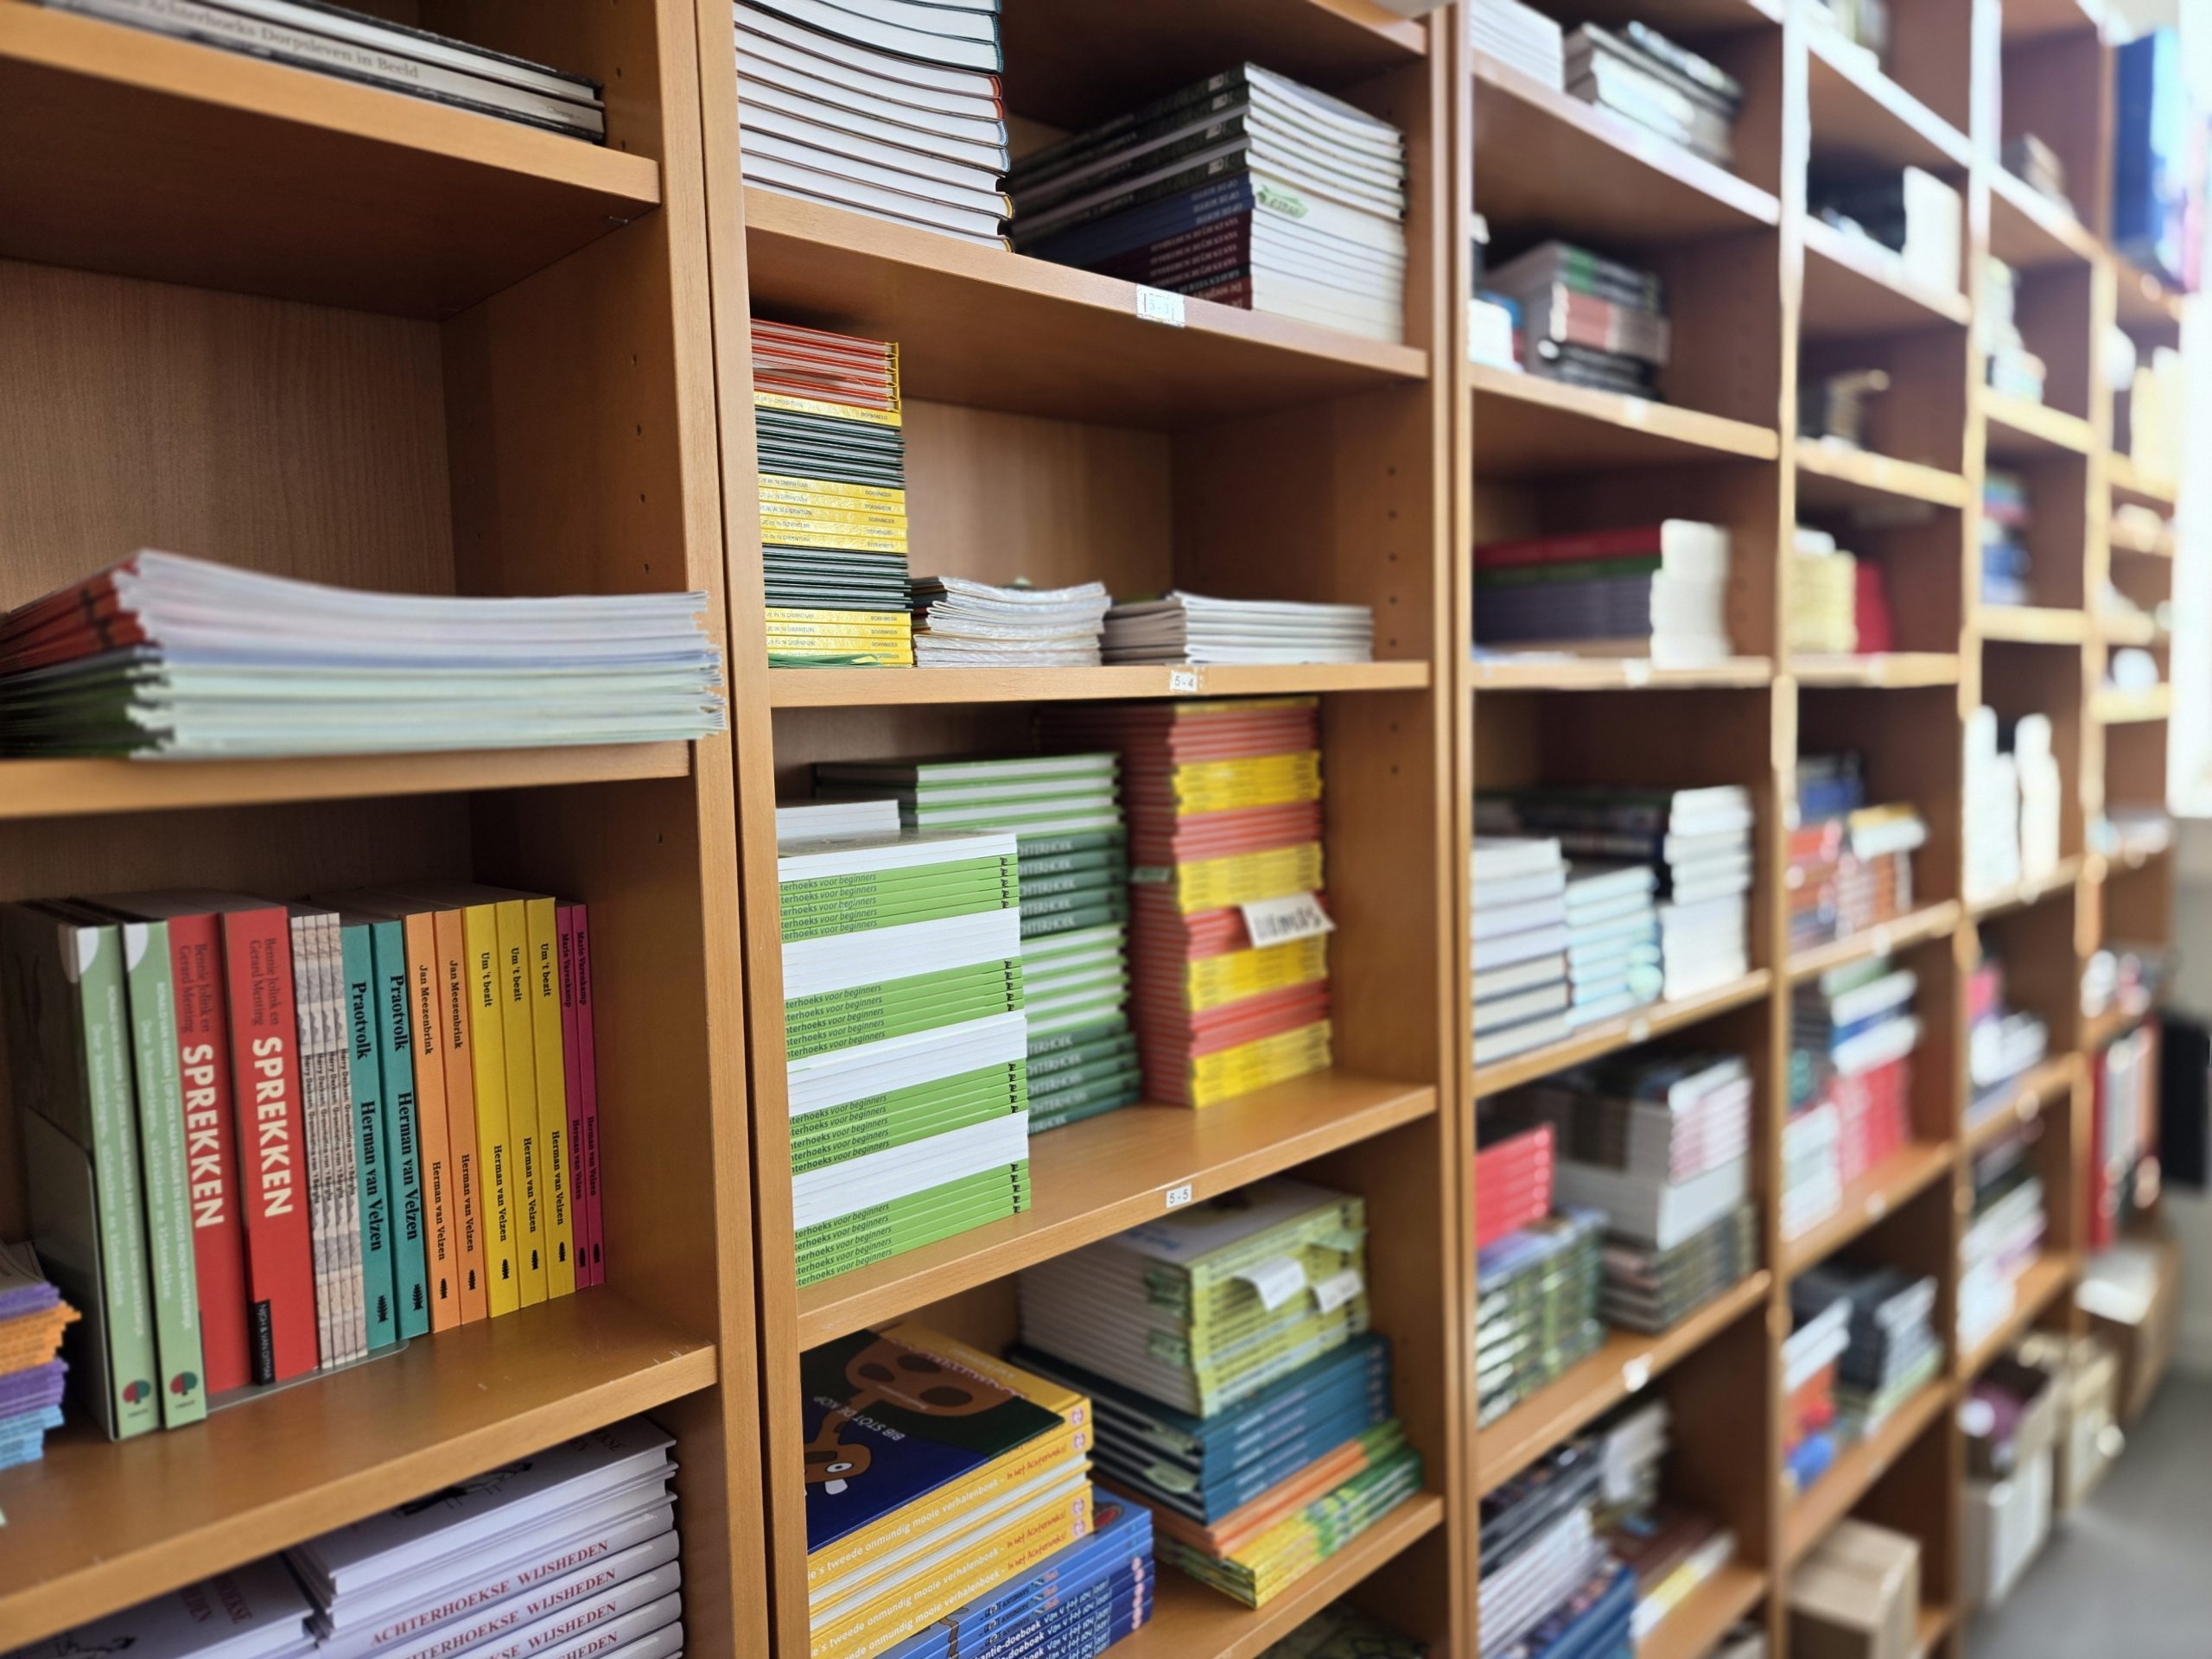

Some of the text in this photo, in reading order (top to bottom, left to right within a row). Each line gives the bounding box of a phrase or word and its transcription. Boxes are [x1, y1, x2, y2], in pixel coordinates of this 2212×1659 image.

[261, 26, 353, 60] Dorpsleven
[357, 49, 372, 67] in
[378, 54, 418, 79] Beeld
[819, 878, 837, 887] voor
[839, 873, 877, 886] beginners
[820, 890, 838, 899] voor
[839, 885, 877, 897] beginners
[820, 914, 838, 923] voor
[839, 908, 878, 921] beginners
[480, 952, 490, 969] Um
[511, 948, 520, 965] Um
[540, 944, 550, 961] Um
[179, 945, 194, 1033] Gerard Menting
[195, 944, 212, 1032] Bennie Jolink en
[249, 940, 264, 1027] Gerard Menting
[264, 938, 280, 1026] Bennie Jolink en
[483, 983, 493, 1008] bezit
[513, 978, 523, 1002] bezit
[542, 973, 551, 997] bezit
[563, 961, 572, 1007] Varenkamp
[578, 958, 587, 1006] Varenkamp
[824, 992, 843, 1001] voor
[844, 984, 881, 998] beginners
[352, 981, 385, 1253] Praotvolk Herman van Velzen
[390, 974, 419, 1242] Praotvolk Herman van Velzen
[418, 964, 445, 1262] Jan Meezenbrink Herman van Velzen
[448, 960, 474, 1253] Jan Meezenbrink Herman van Velzen
[182, 1044, 225, 1229] SPREKKEN
[252, 1036, 293, 1218] SPREKKEN
[493, 1145, 503, 1184] Herman
[524, 1137, 533, 1176] Herman
[551, 1130, 561, 1169] Herman
[833, 1151, 851, 1161] voor
[852, 1141, 890, 1156] beginners
[554, 1171, 563, 1188] van
[498, 1205, 506, 1242] Velzen
[527, 1197, 537, 1233] Velzen
[556, 1190, 564, 1226] Velzen
[833, 1216, 851, 1226] voor
[852, 1203, 889, 1220] beginners
[812, 1395, 839, 1409] KOP
[839, 1405, 857, 1418] DE
[882, 1428, 906, 1441] BIB
[827, 1547, 862, 1570] tweede
[865, 1522, 912, 1552] onmundig
[912, 1508, 940, 1530] mooie
[941, 1479, 999, 1512] verhalenboek
[371, 1540, 609, 1646] ACHTERHOEKSE WIJSHEDEN
[525, 1568, 616, 1616] WIJSHEDEN
[829, 1624, 864, 1648] tweede
[867, 1596, 912, 1626] onmundig
[913, 1580, 941, 1602] mooie
[943, 1548, 1000, 1584] verhalenboek
[1044, 1612, 1058, 1624] van
[1065, 1596, 1079, 1611] tot
[527, 1601, 617, 1649] WIJSHEDEN
